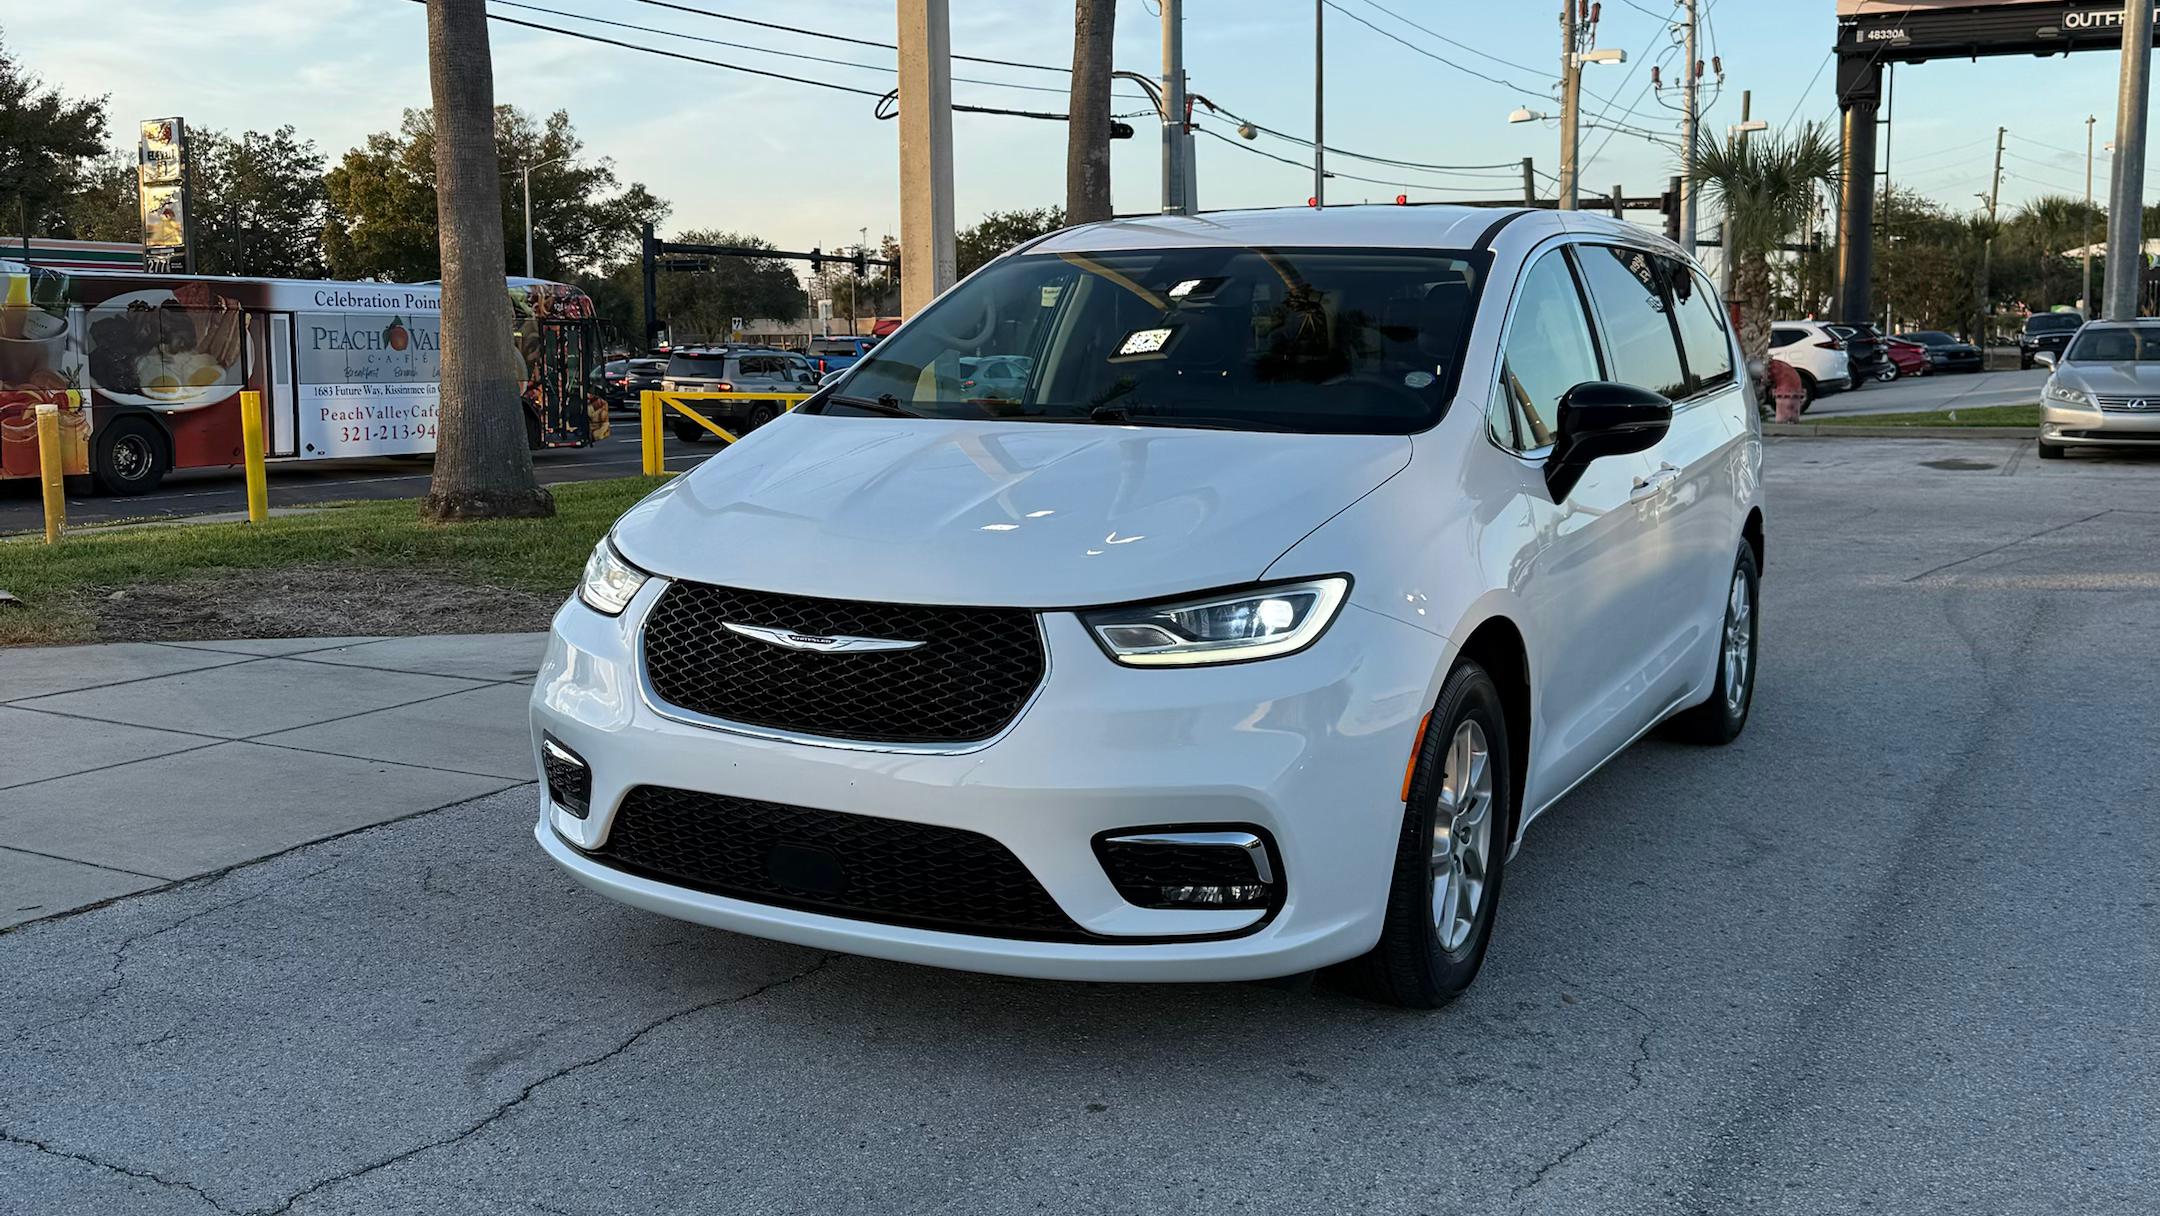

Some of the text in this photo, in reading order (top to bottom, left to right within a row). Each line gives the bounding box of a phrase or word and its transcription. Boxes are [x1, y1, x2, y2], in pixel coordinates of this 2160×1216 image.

[314, 290, 401, 308] Celebration
[311, 326, 381, 350] PEACH
[314, 386, 333, 397] 1683
[335, 385, 362, 396] Future
[363, 384, 383, 398] Way,
[385, 384, 425, 396] Kissimmee
